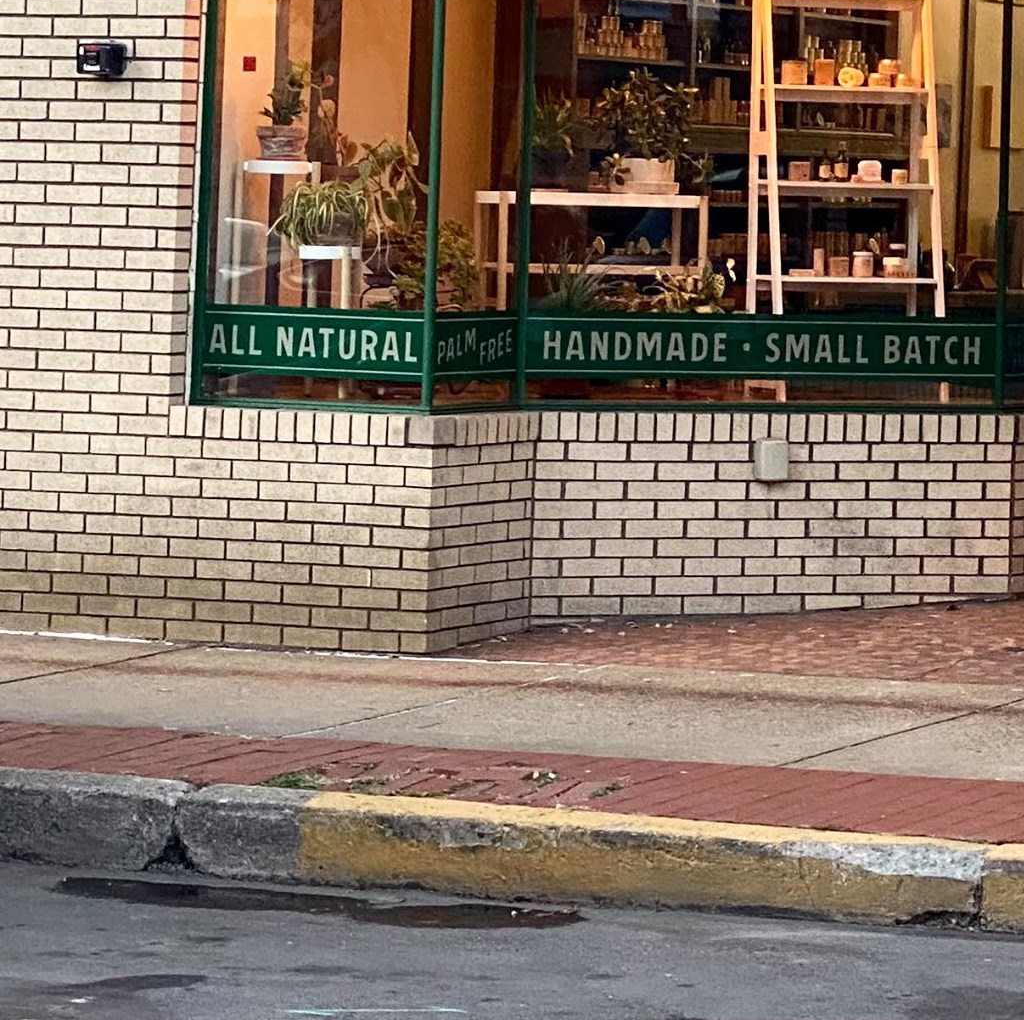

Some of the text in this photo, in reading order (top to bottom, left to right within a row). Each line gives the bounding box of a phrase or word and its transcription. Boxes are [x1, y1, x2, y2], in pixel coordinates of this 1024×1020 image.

[209, 324, 418, 362] ALL NATURAL
[437, 328, 513, 365] PALM FREE
[542, 330, 728, 362] HANDMADE
[765, 332, 869, 364] SMALL
[884, 334, 982, 366] BATCH
